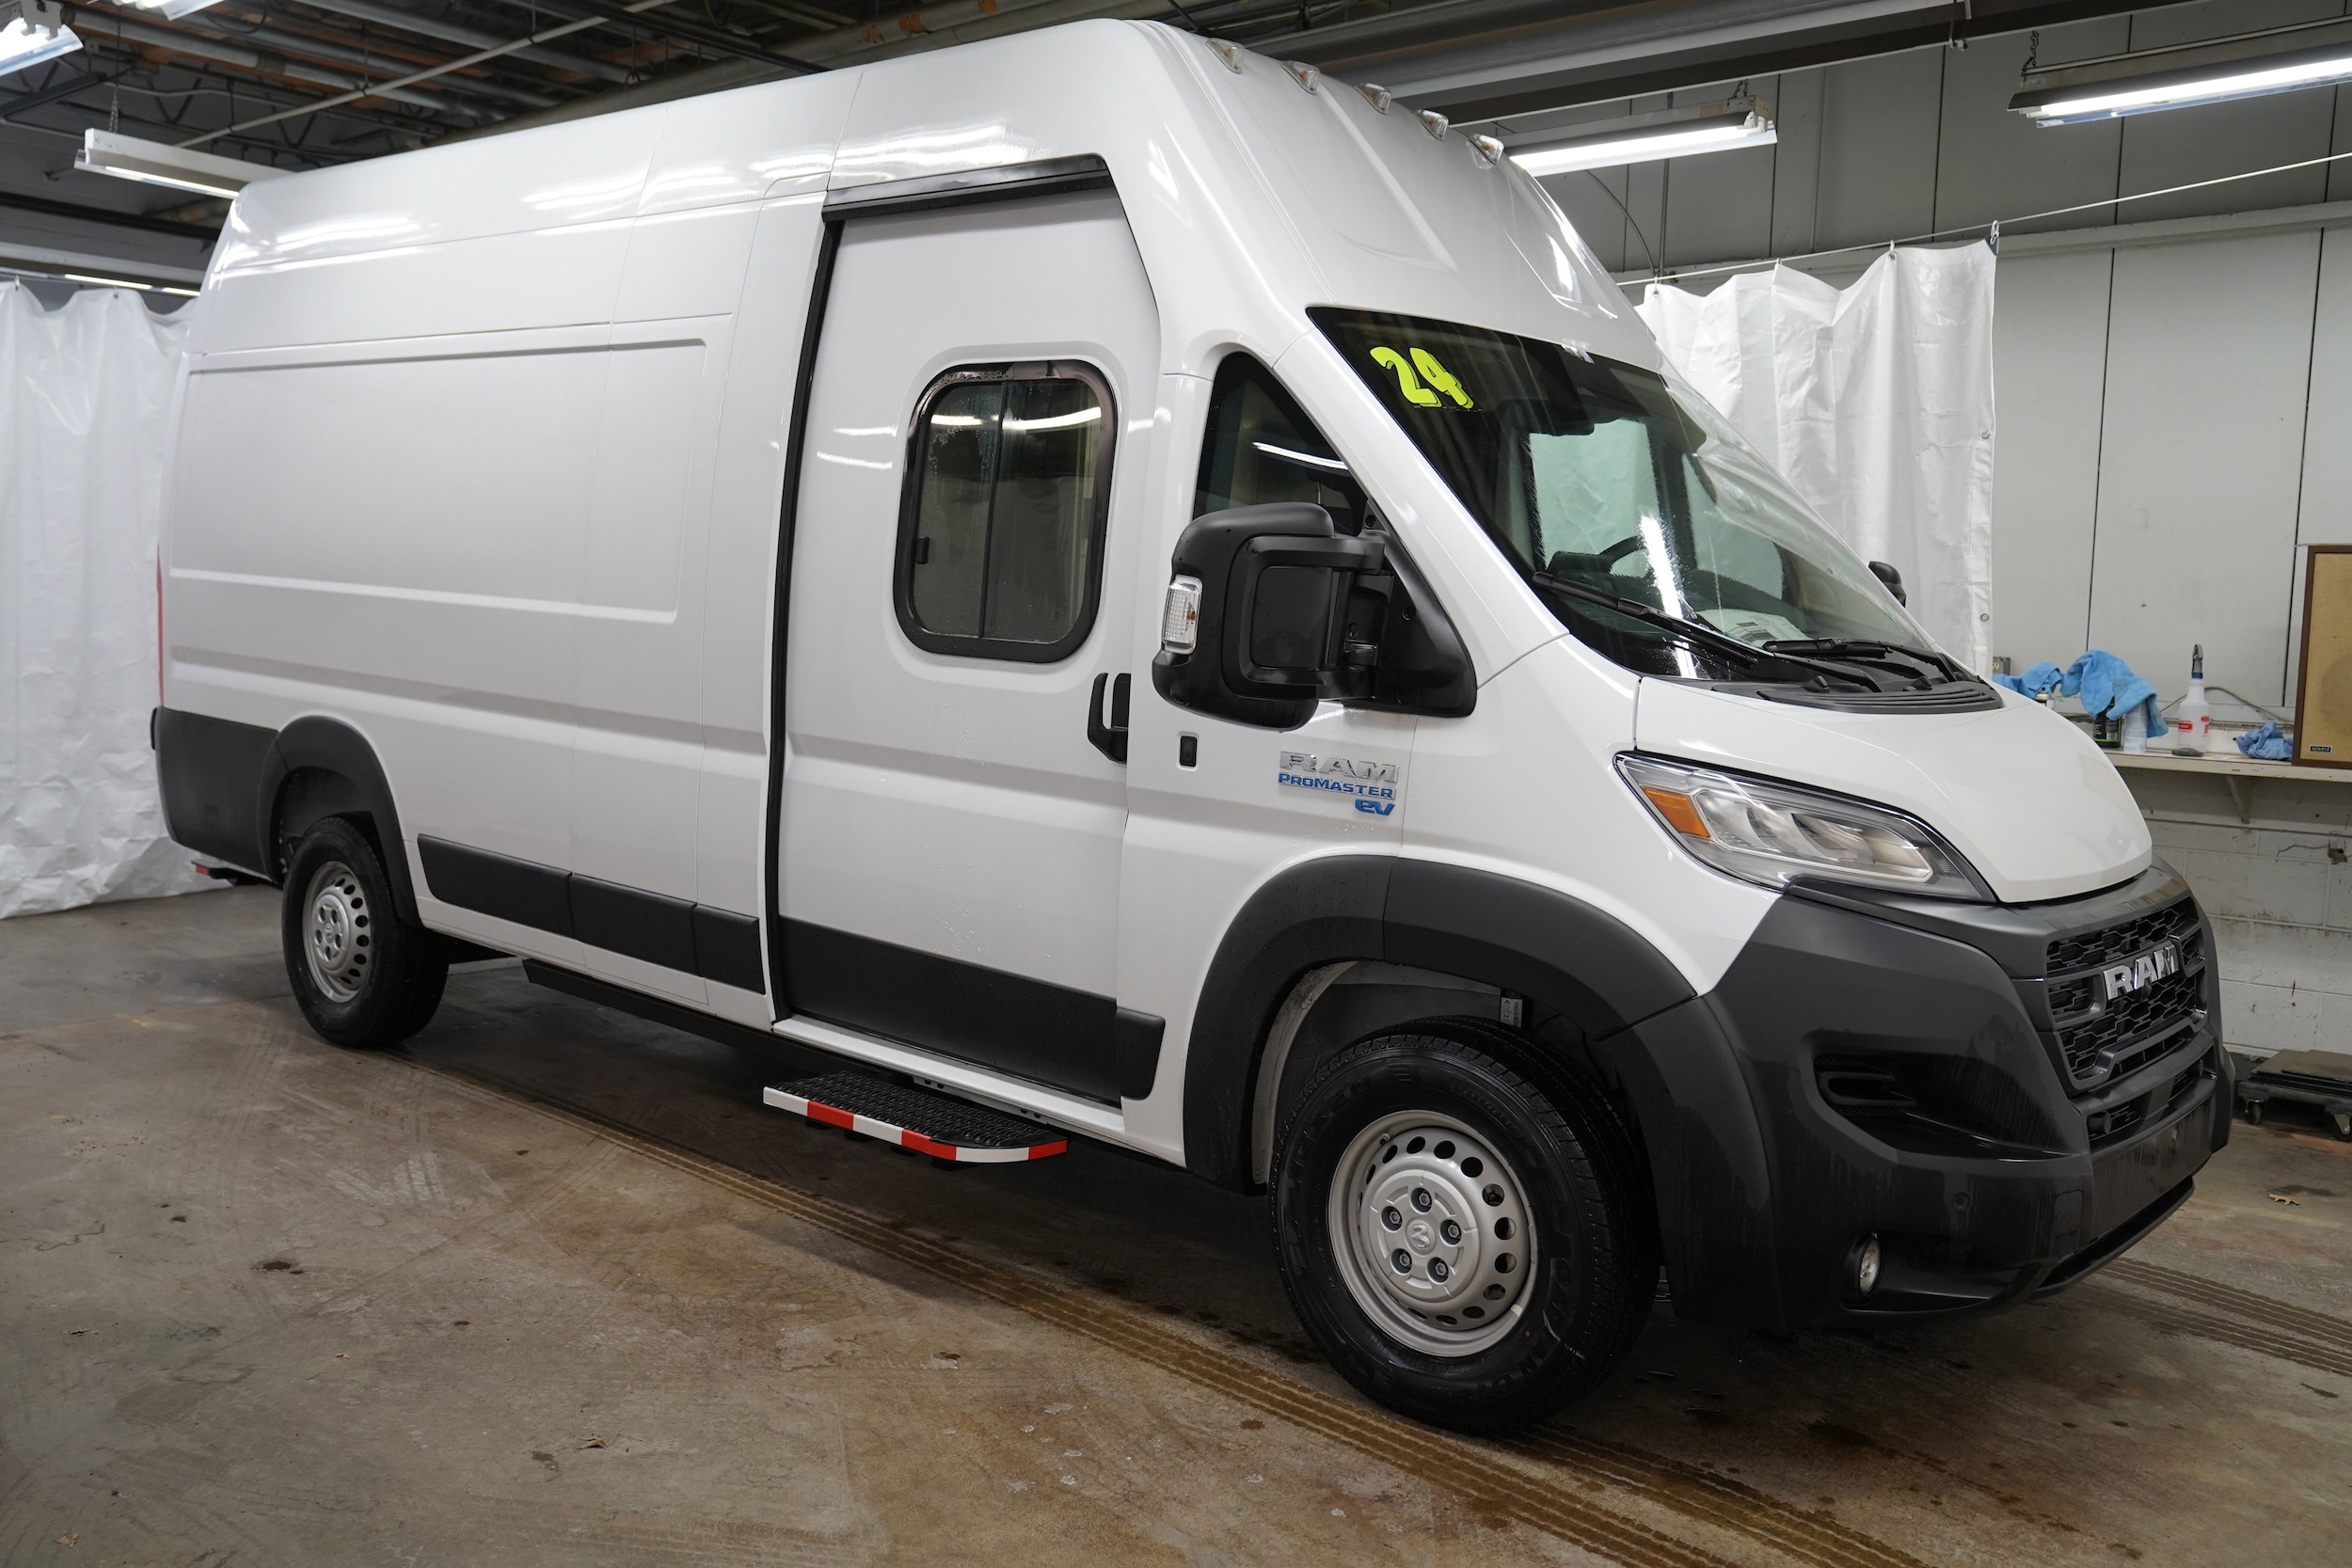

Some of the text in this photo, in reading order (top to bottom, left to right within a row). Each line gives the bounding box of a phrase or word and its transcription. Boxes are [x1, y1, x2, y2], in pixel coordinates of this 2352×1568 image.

[1370, 346, 1473, 409] 24
[1279, 751, 1399, 784] RAM
[2103, 944, 2180, 1000] RAM
